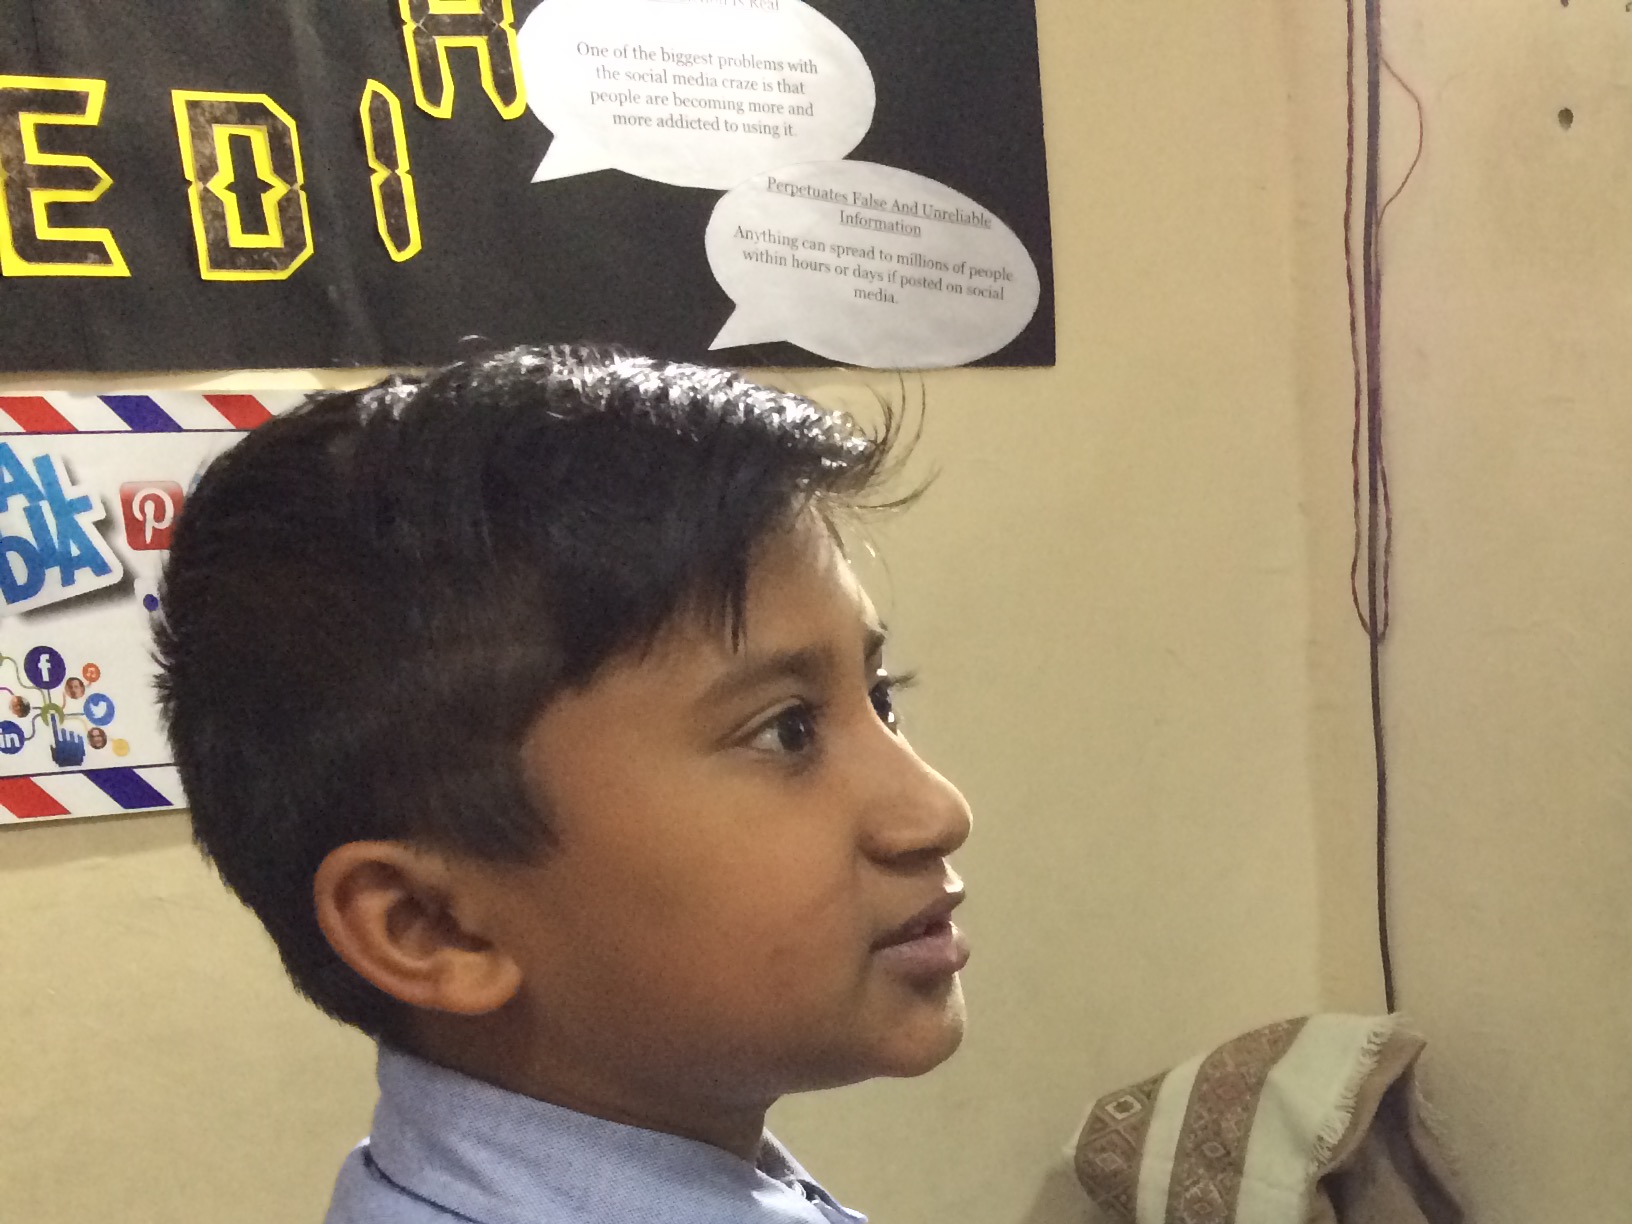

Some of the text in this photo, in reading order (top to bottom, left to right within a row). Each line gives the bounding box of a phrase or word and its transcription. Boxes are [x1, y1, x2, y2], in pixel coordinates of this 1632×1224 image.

[577, 41, 818, 74] One of the biggest problems with
[596, 65, 805, 95] the social media craze is that
[590, 89, 814, 117] people are becoming more and
[613, 113, 652, 127] more
[656, 115, 720, 131] addicted
[724, 118, 738, 133] to
[742, 122, 780, 139] using
[767, 176, 992, 229] Perpetuates False And Unreliable
[840, 210, 922, 236] Information
[733, 225, 1013, 282] Anything can spread to millions of people
[742, 249, 1005, 301] within hours or days if posted on social
[853, 288, 899, 304] media.
